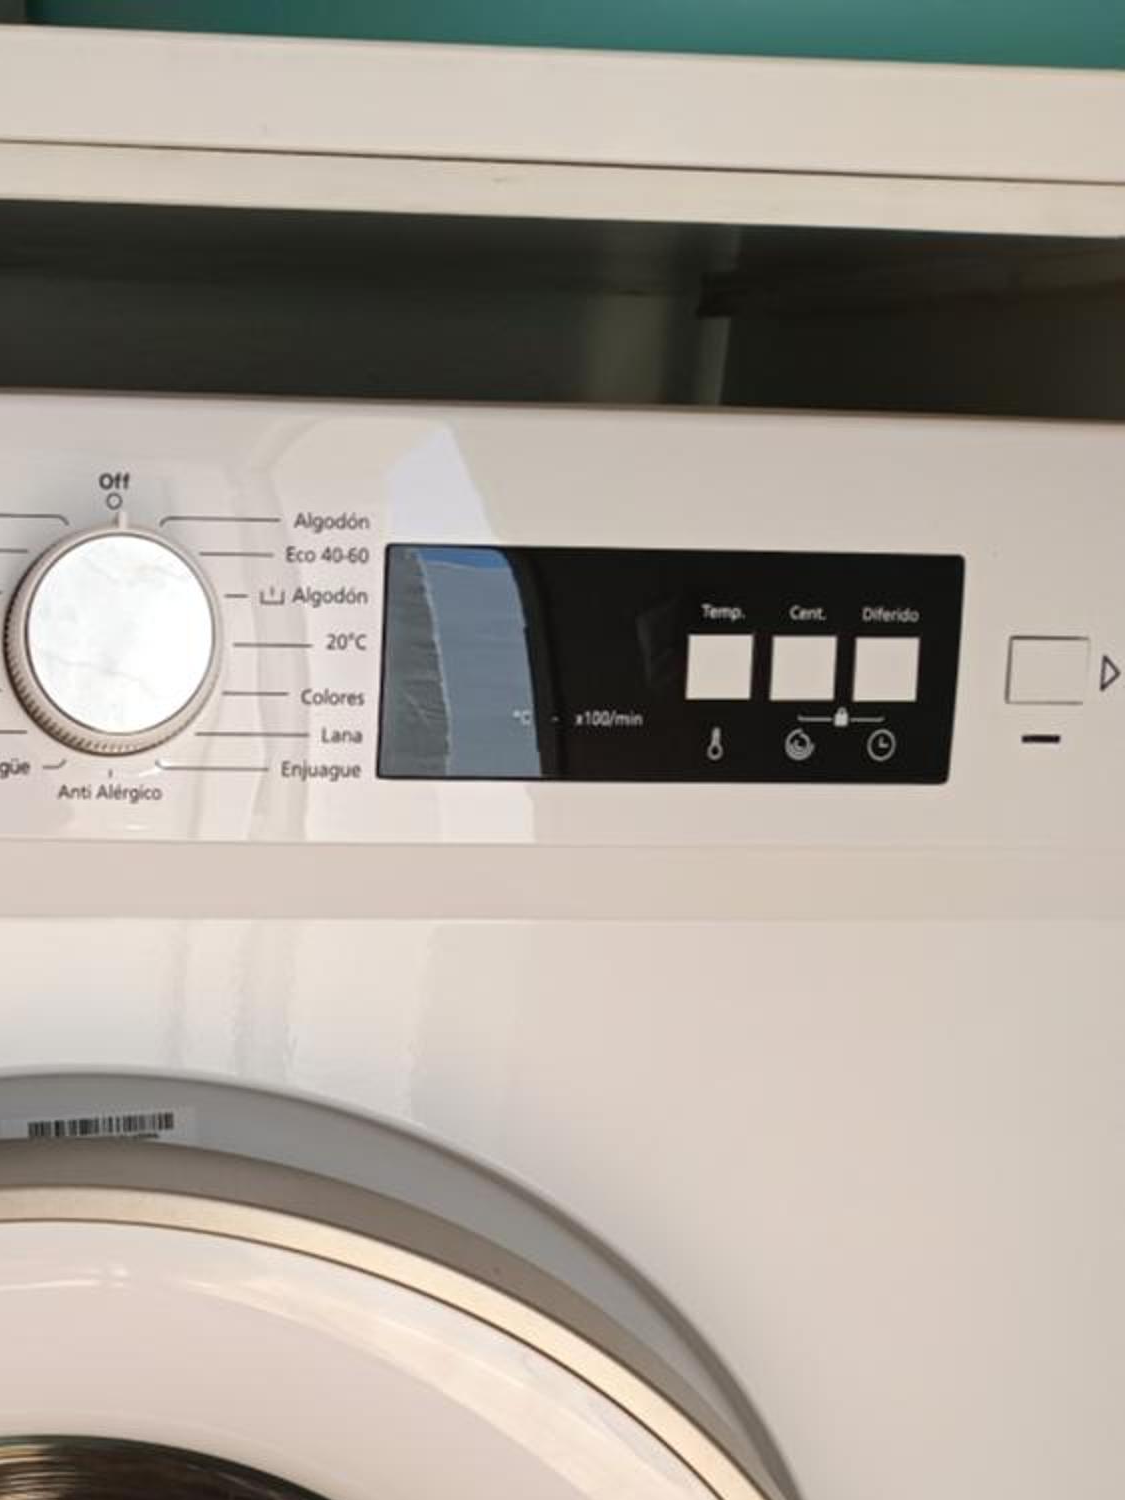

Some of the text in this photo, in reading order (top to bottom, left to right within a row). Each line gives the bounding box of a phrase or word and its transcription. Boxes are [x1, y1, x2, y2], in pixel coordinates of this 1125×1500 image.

[99, 473, 130, 490] Off
[294, 512, 369, 532] Algodón
[286, 547, 369, 564] Eco 40-60
[292, 587, 368, 608] Algodón
[701, 603, 746, 621] Temp.
[789, 605, 826, 621] Cent.
[862, 606, 920, 622] Diferido
[326, 633, 367, 650] 20°C
[301, 689, 365, 706] Colores
[321, 727, 363, 744] Lana
[281, 761, 361, 781] Enjuague
[58, 783, 163, 804] Anti Alérgico
